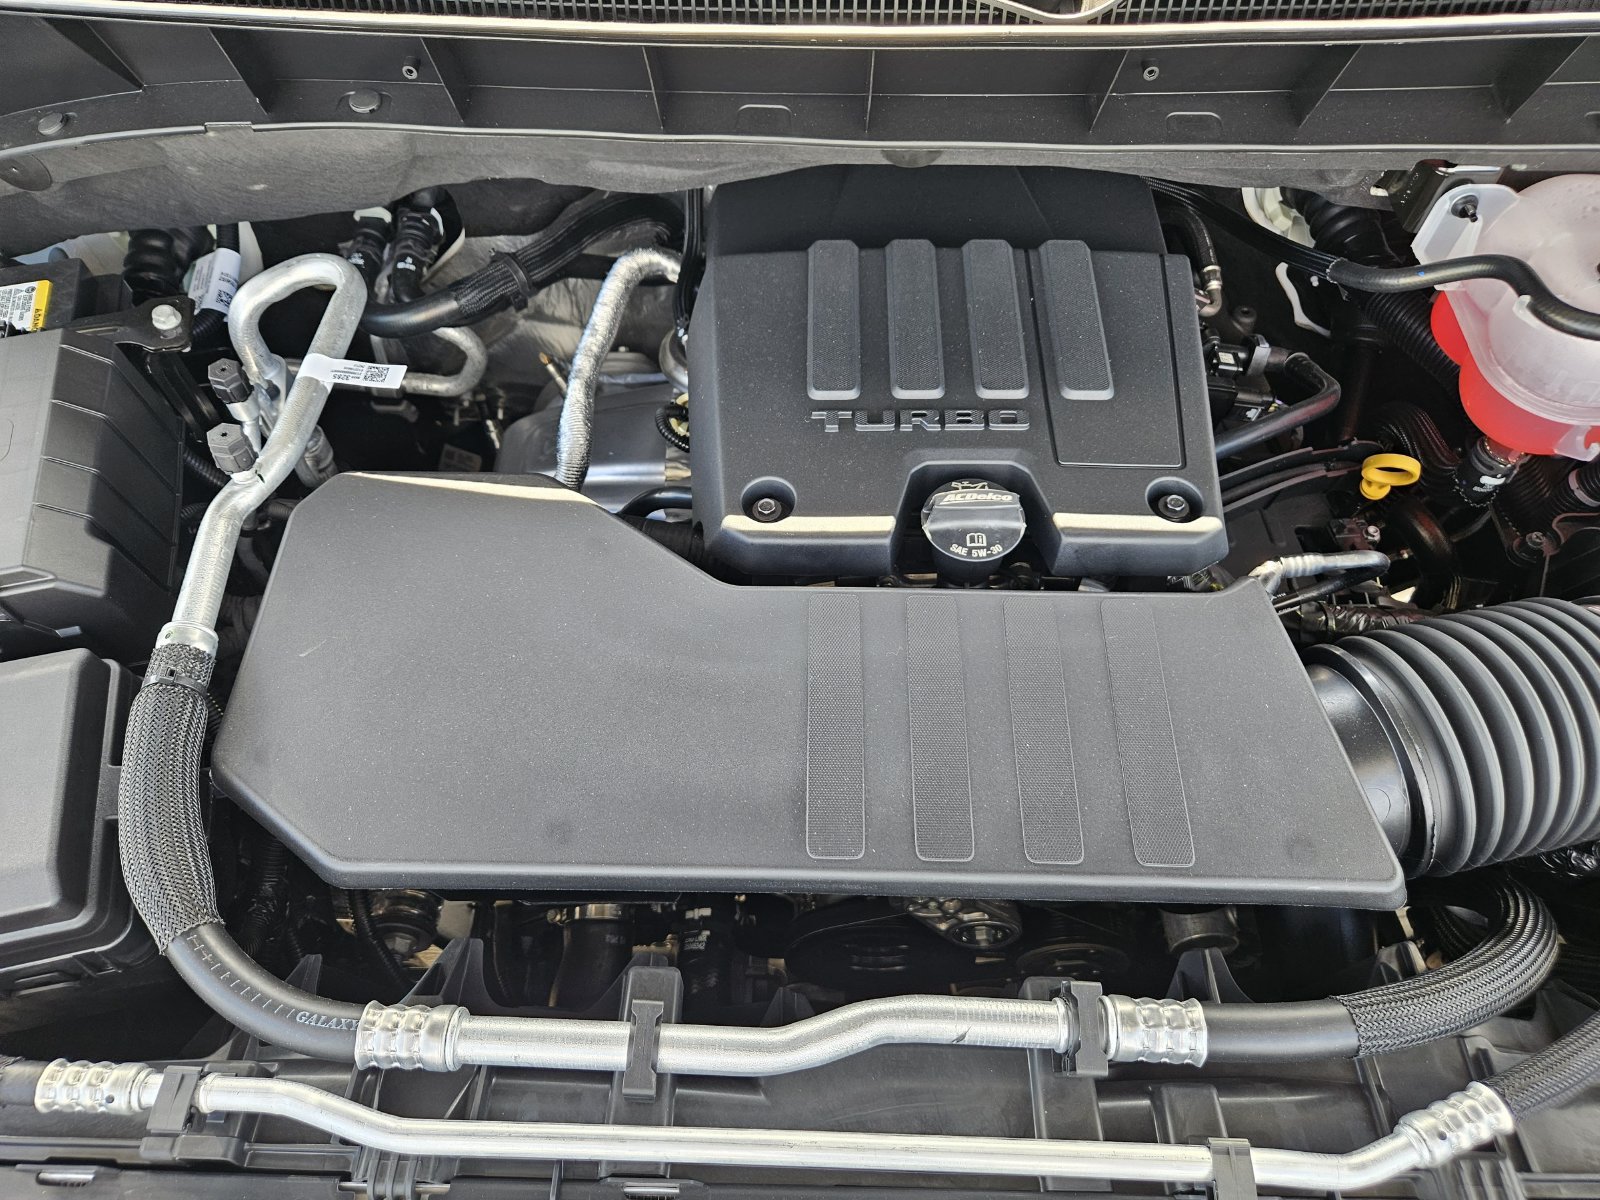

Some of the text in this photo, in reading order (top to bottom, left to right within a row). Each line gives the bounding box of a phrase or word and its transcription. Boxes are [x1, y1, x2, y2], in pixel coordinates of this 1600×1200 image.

[810, 409, 1030, 432] TURBO
[941, 492, 1013, 503] ACDelco
[950, 543, 1003, 557] SAE 5W-30
[296, 1011, 359, 1030] GALAXY
